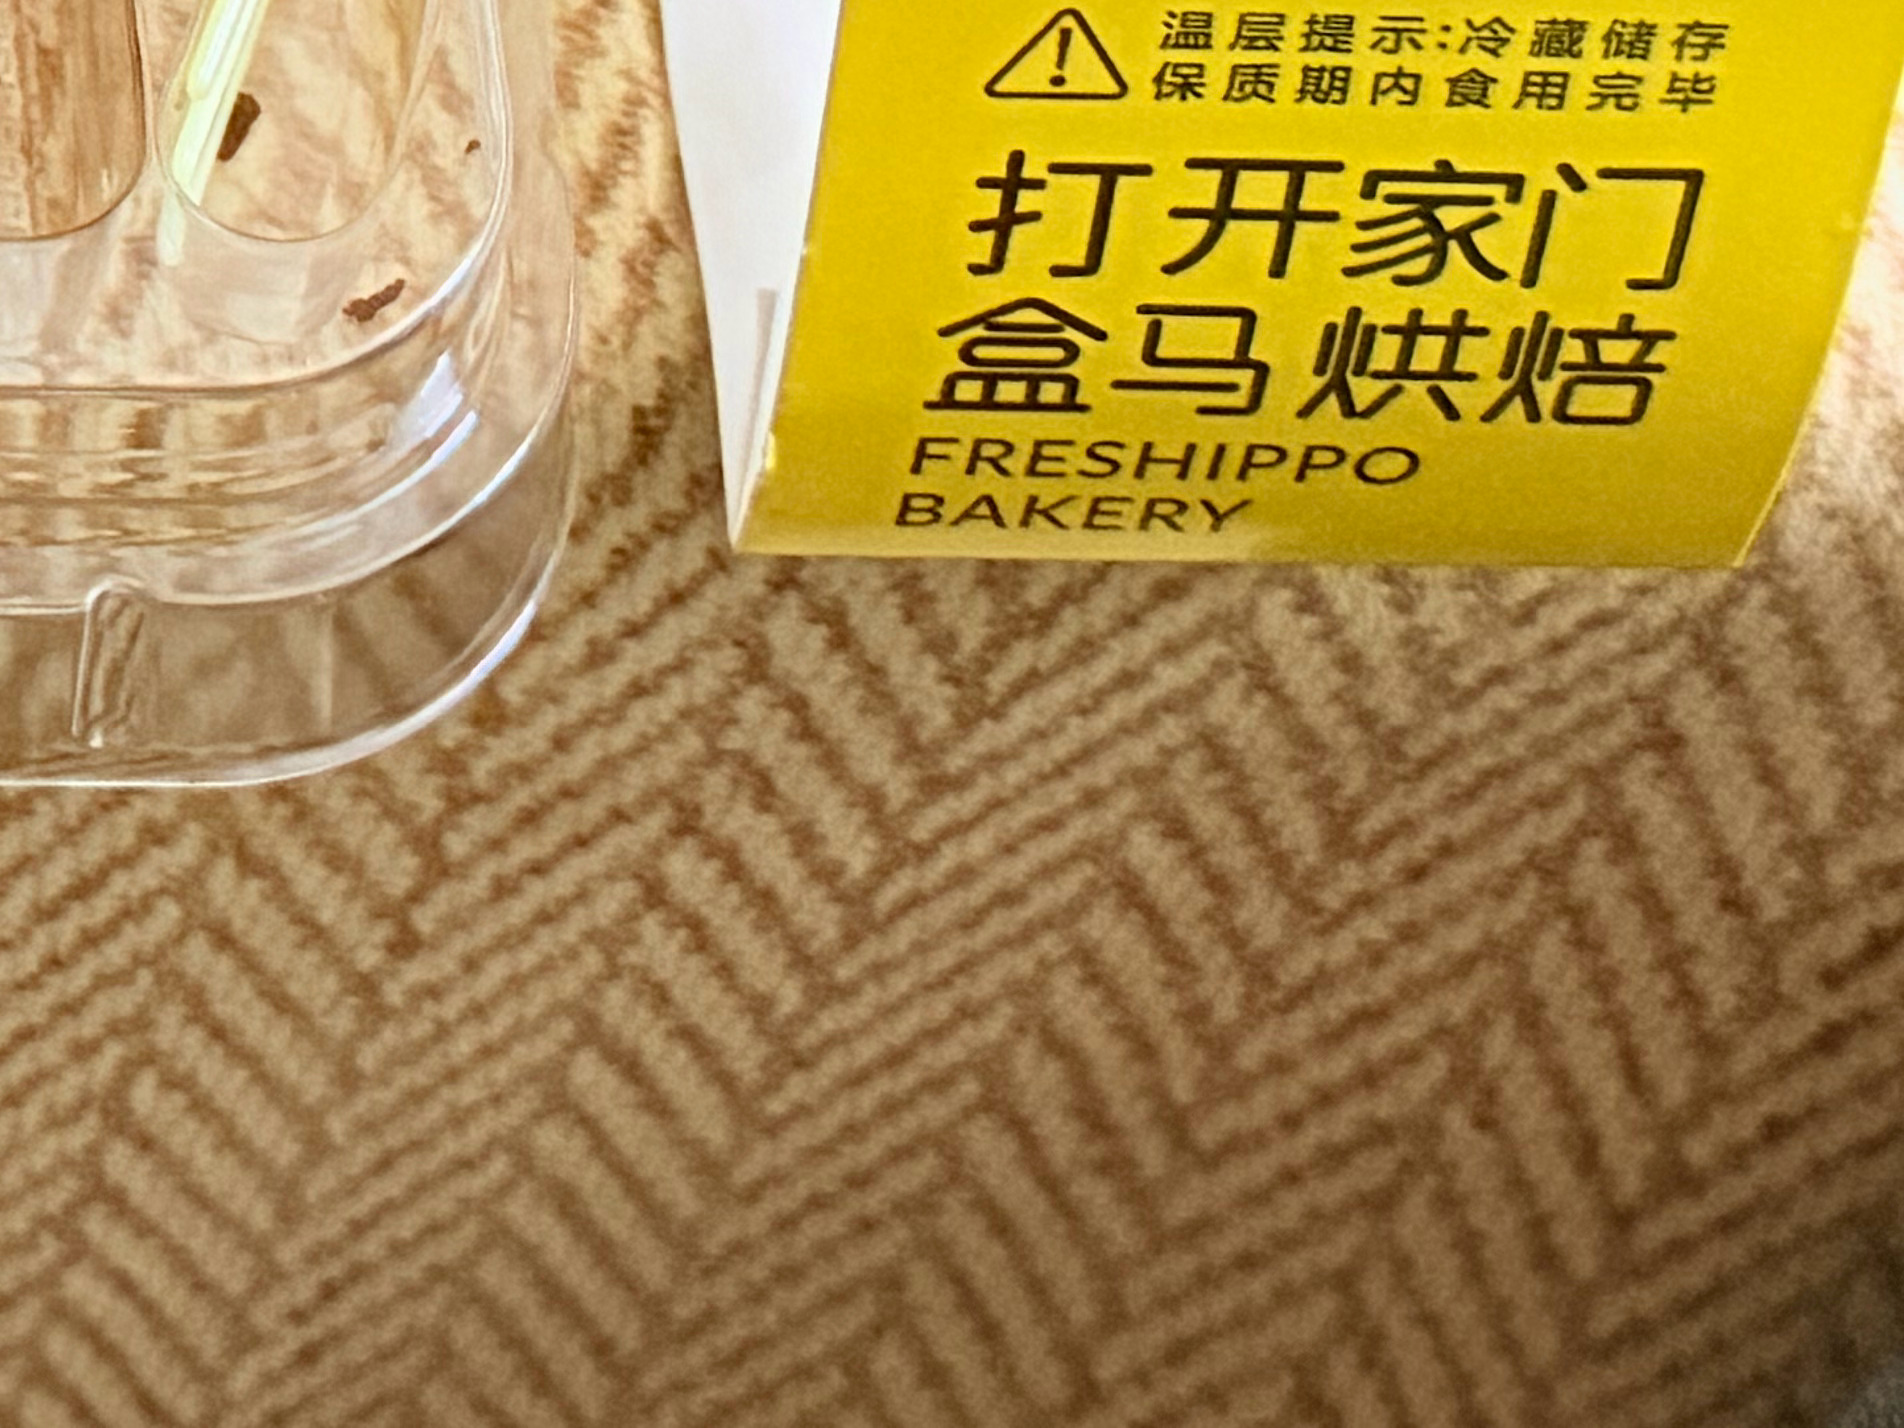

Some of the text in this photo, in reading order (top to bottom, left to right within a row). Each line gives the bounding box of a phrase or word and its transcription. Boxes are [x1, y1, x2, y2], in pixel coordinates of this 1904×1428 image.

[1150, 61, 1720, 115] 保质期内食用完毕
[965, 147, 1707, 292] 打开家门
[922, 295, 1677, 428] 盒马烘焙
[906, 436, 1422, 487] FRESHIPPO
[894, 492, 1253, 535] BAKERY
